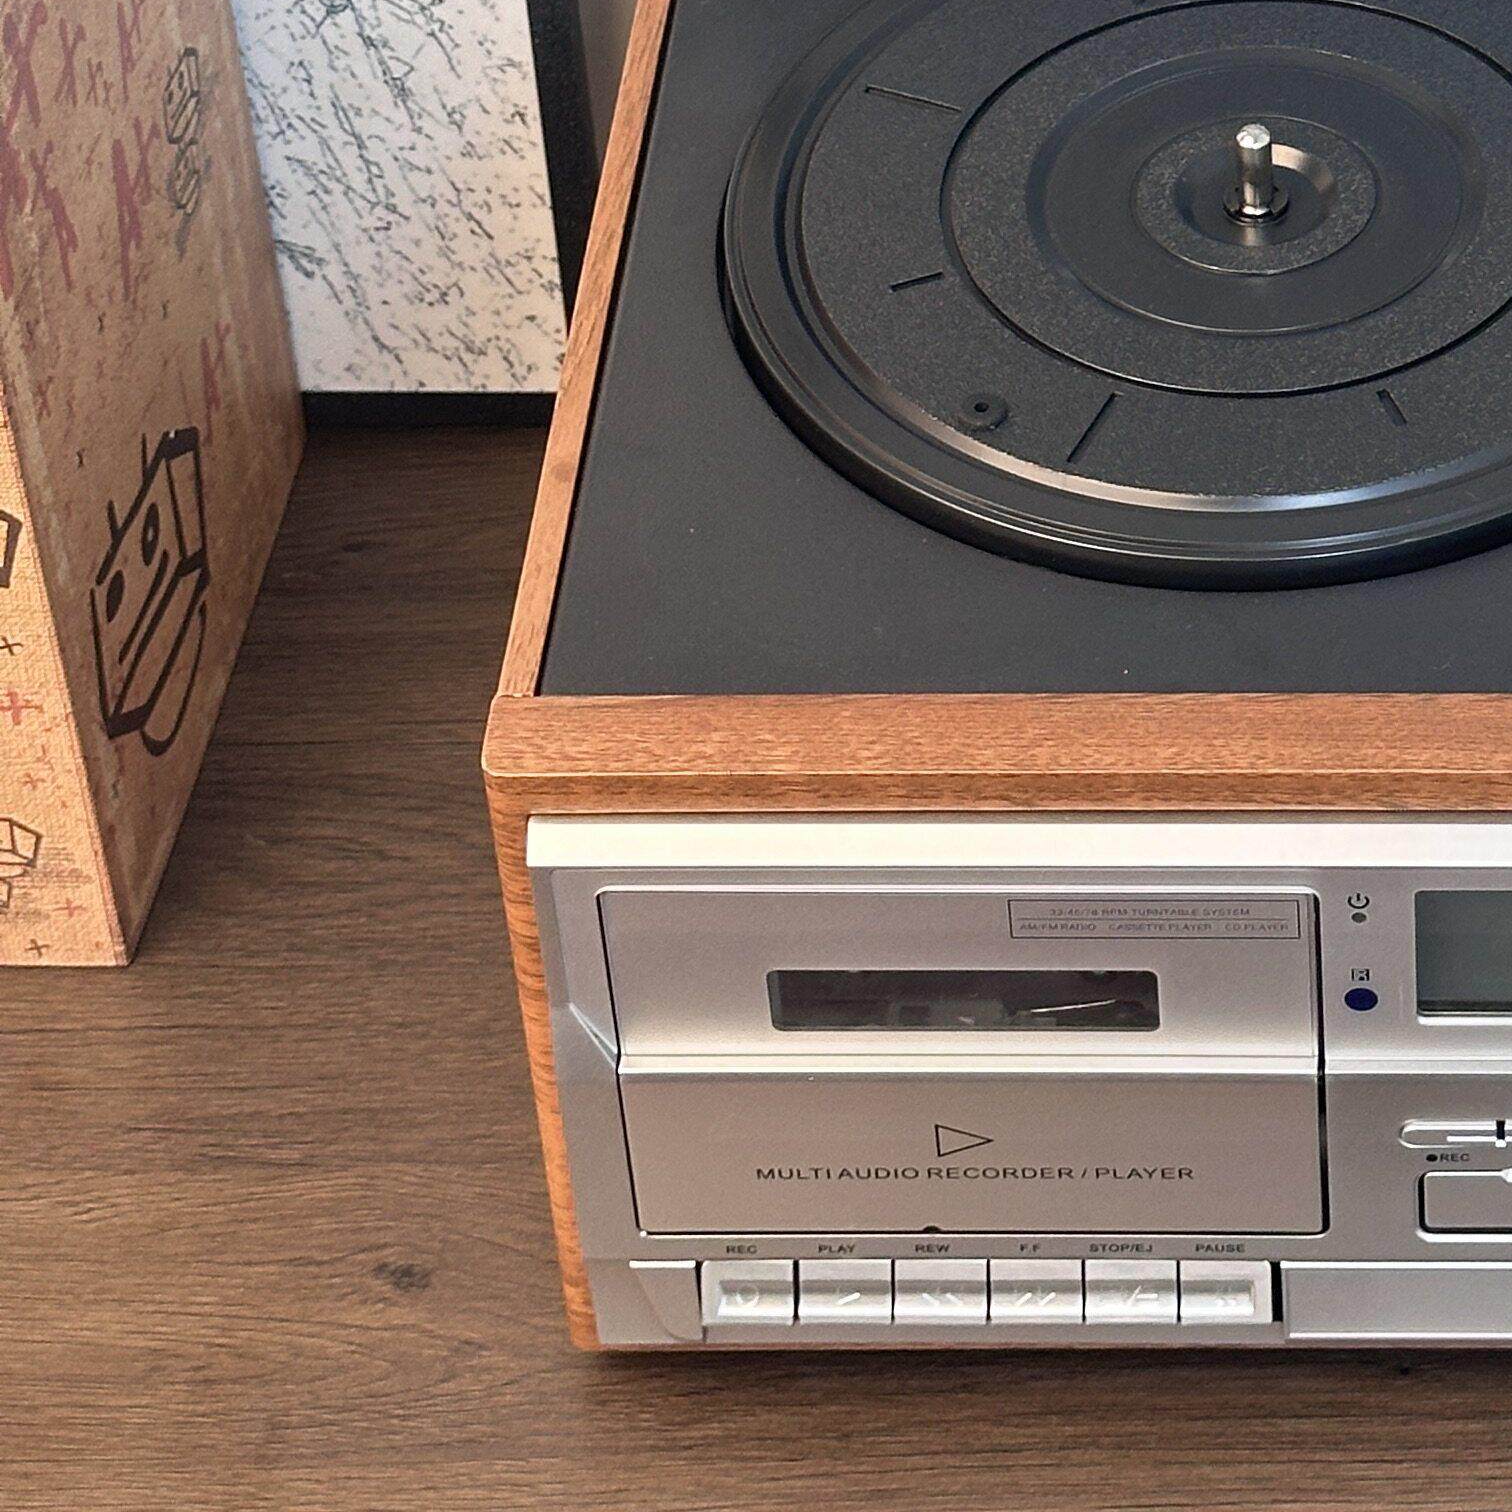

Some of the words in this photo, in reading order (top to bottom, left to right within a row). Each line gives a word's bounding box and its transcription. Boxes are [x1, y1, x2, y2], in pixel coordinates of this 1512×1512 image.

[1439, 1153, 1471, 1163] REC
[756, 1167, 832, 1180] MULTI
[838, 1167, 920, 1180] AUDIO
[926, 1167, 1075, 1180] RECORDER
[1095, 1167, 1195, 1180] PLAYER
[726, 1244, 758, 1254] REC
[818, 1244, 856, 1254] PLAY
[915, 1244, 951, 1254] REW
[1089, 1243, 1153, 1253] STOP/EJ
[1195, 1243, 1246, 1253] PAUSE
